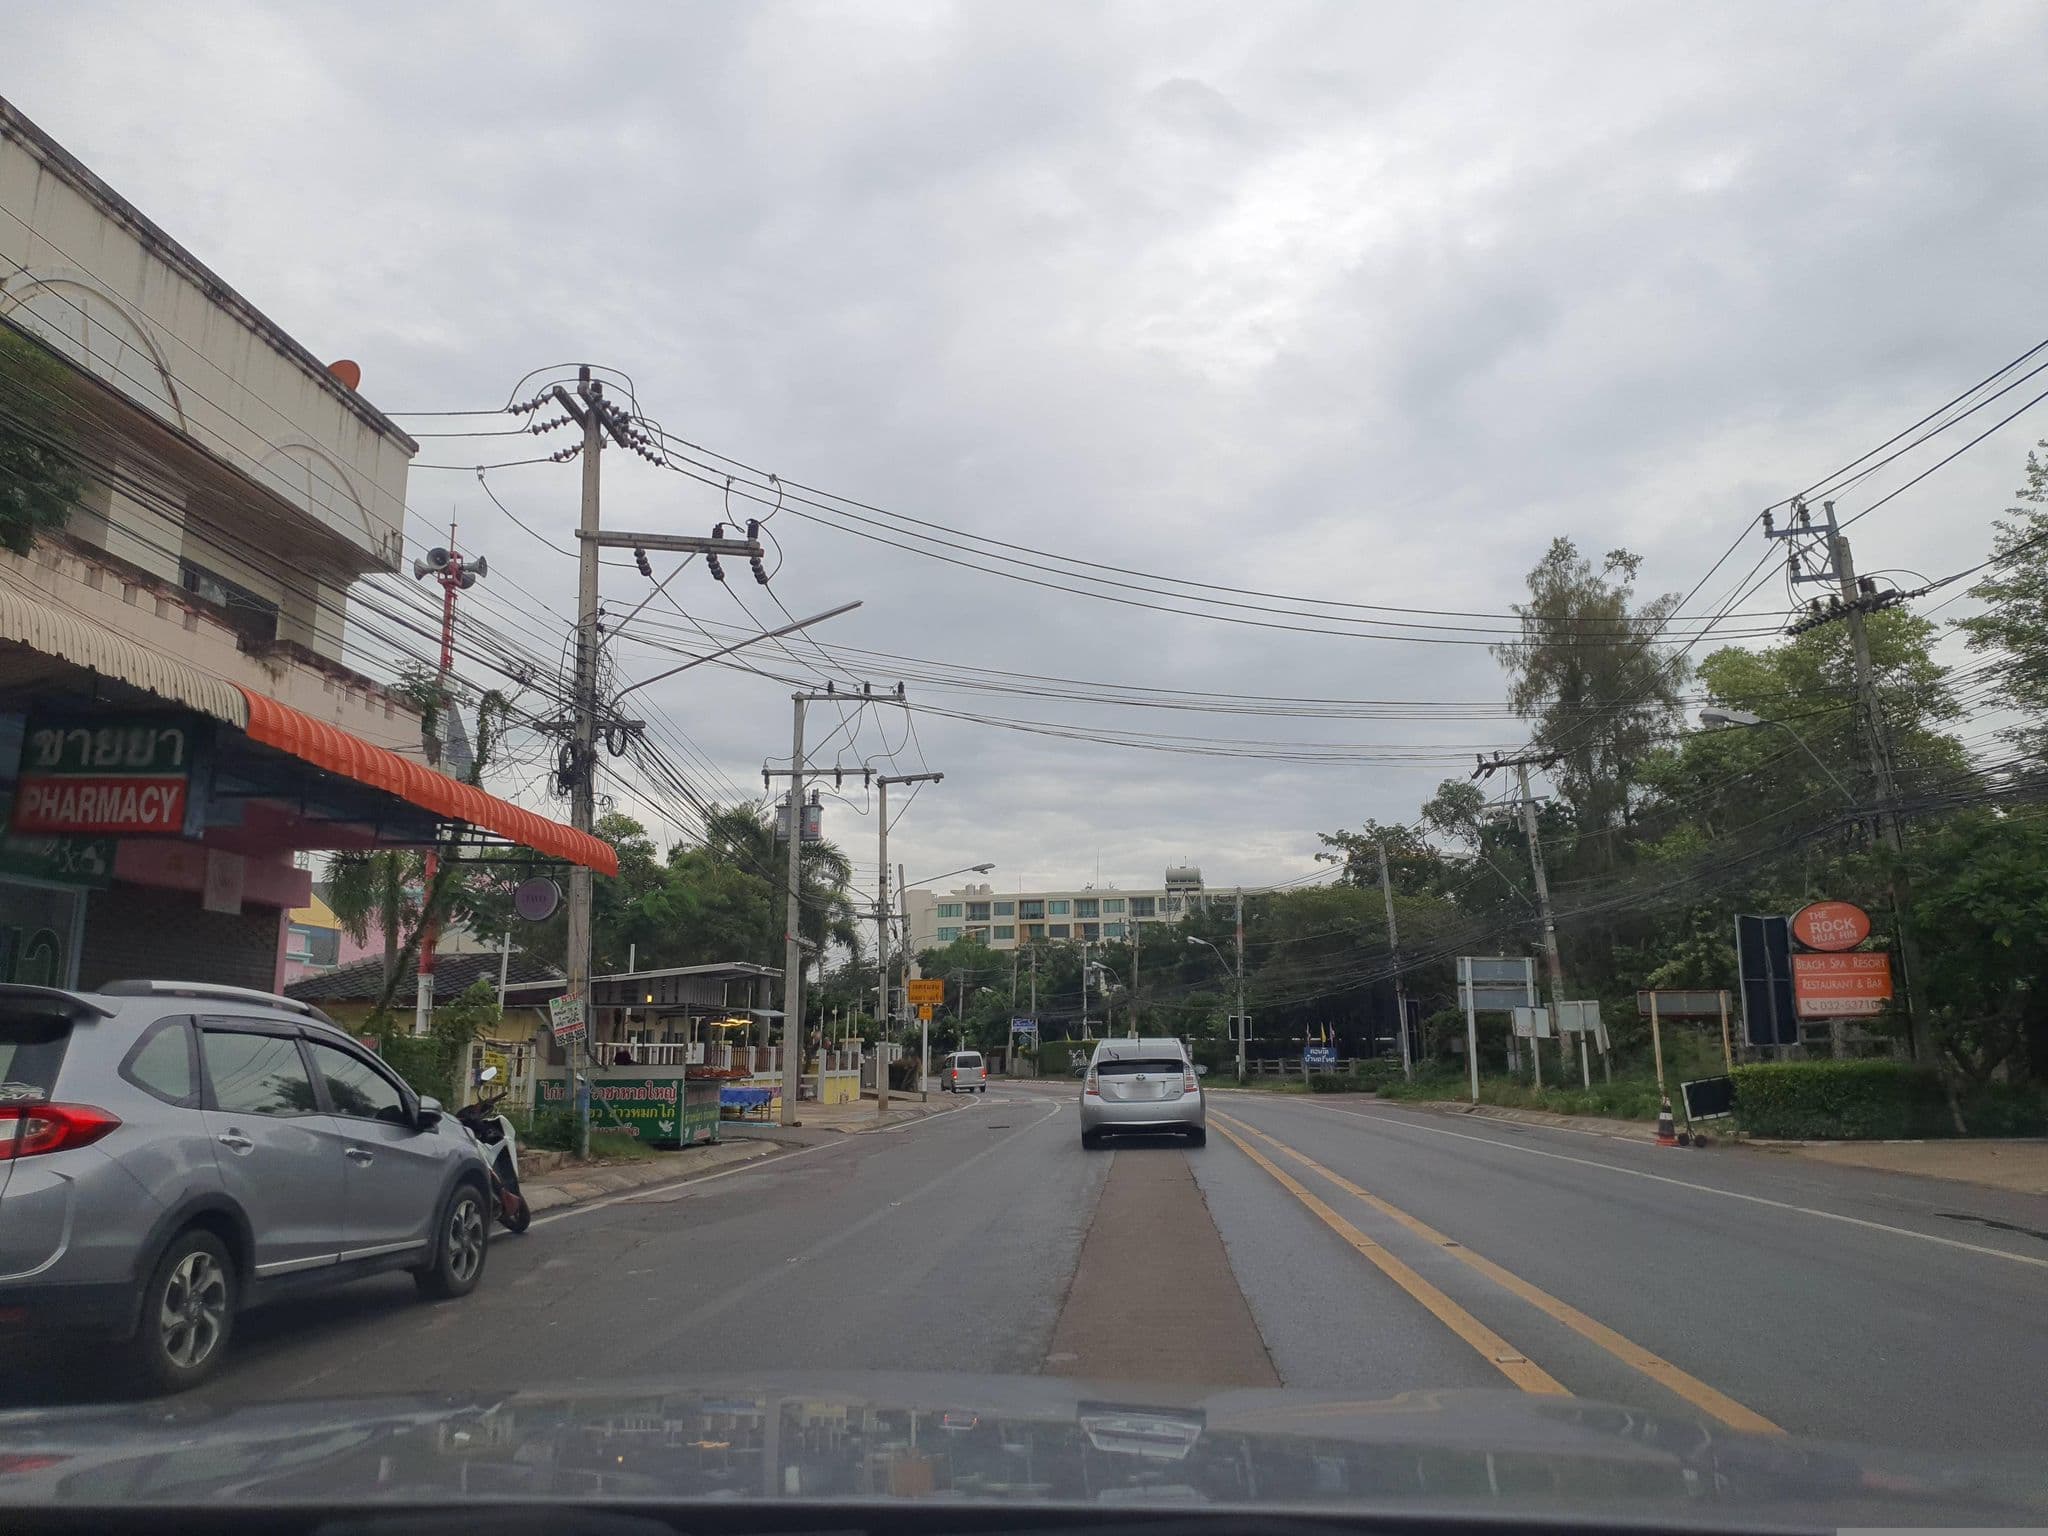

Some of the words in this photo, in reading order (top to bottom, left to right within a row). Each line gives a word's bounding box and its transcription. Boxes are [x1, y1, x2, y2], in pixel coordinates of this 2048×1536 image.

[33, 728, 185, 766] ขายยา
[22, 786, 179, 824] PHARMACY
[1809, 910, 1828, 920] THE
[1810, 917, 1856, 934] ROCK
[1812, 933, 1835, 943] HUA
[1840, 930, 1857, 940] HIN
[1795, 957, 1825, 970] BEACH
[1852, 956, 1886, 969] RESORT
[1802, 978, 1853, 989] RESTAURANT
[1857, 978, 1864, 989] &
[1867, 978, 1881, 989] BAR
